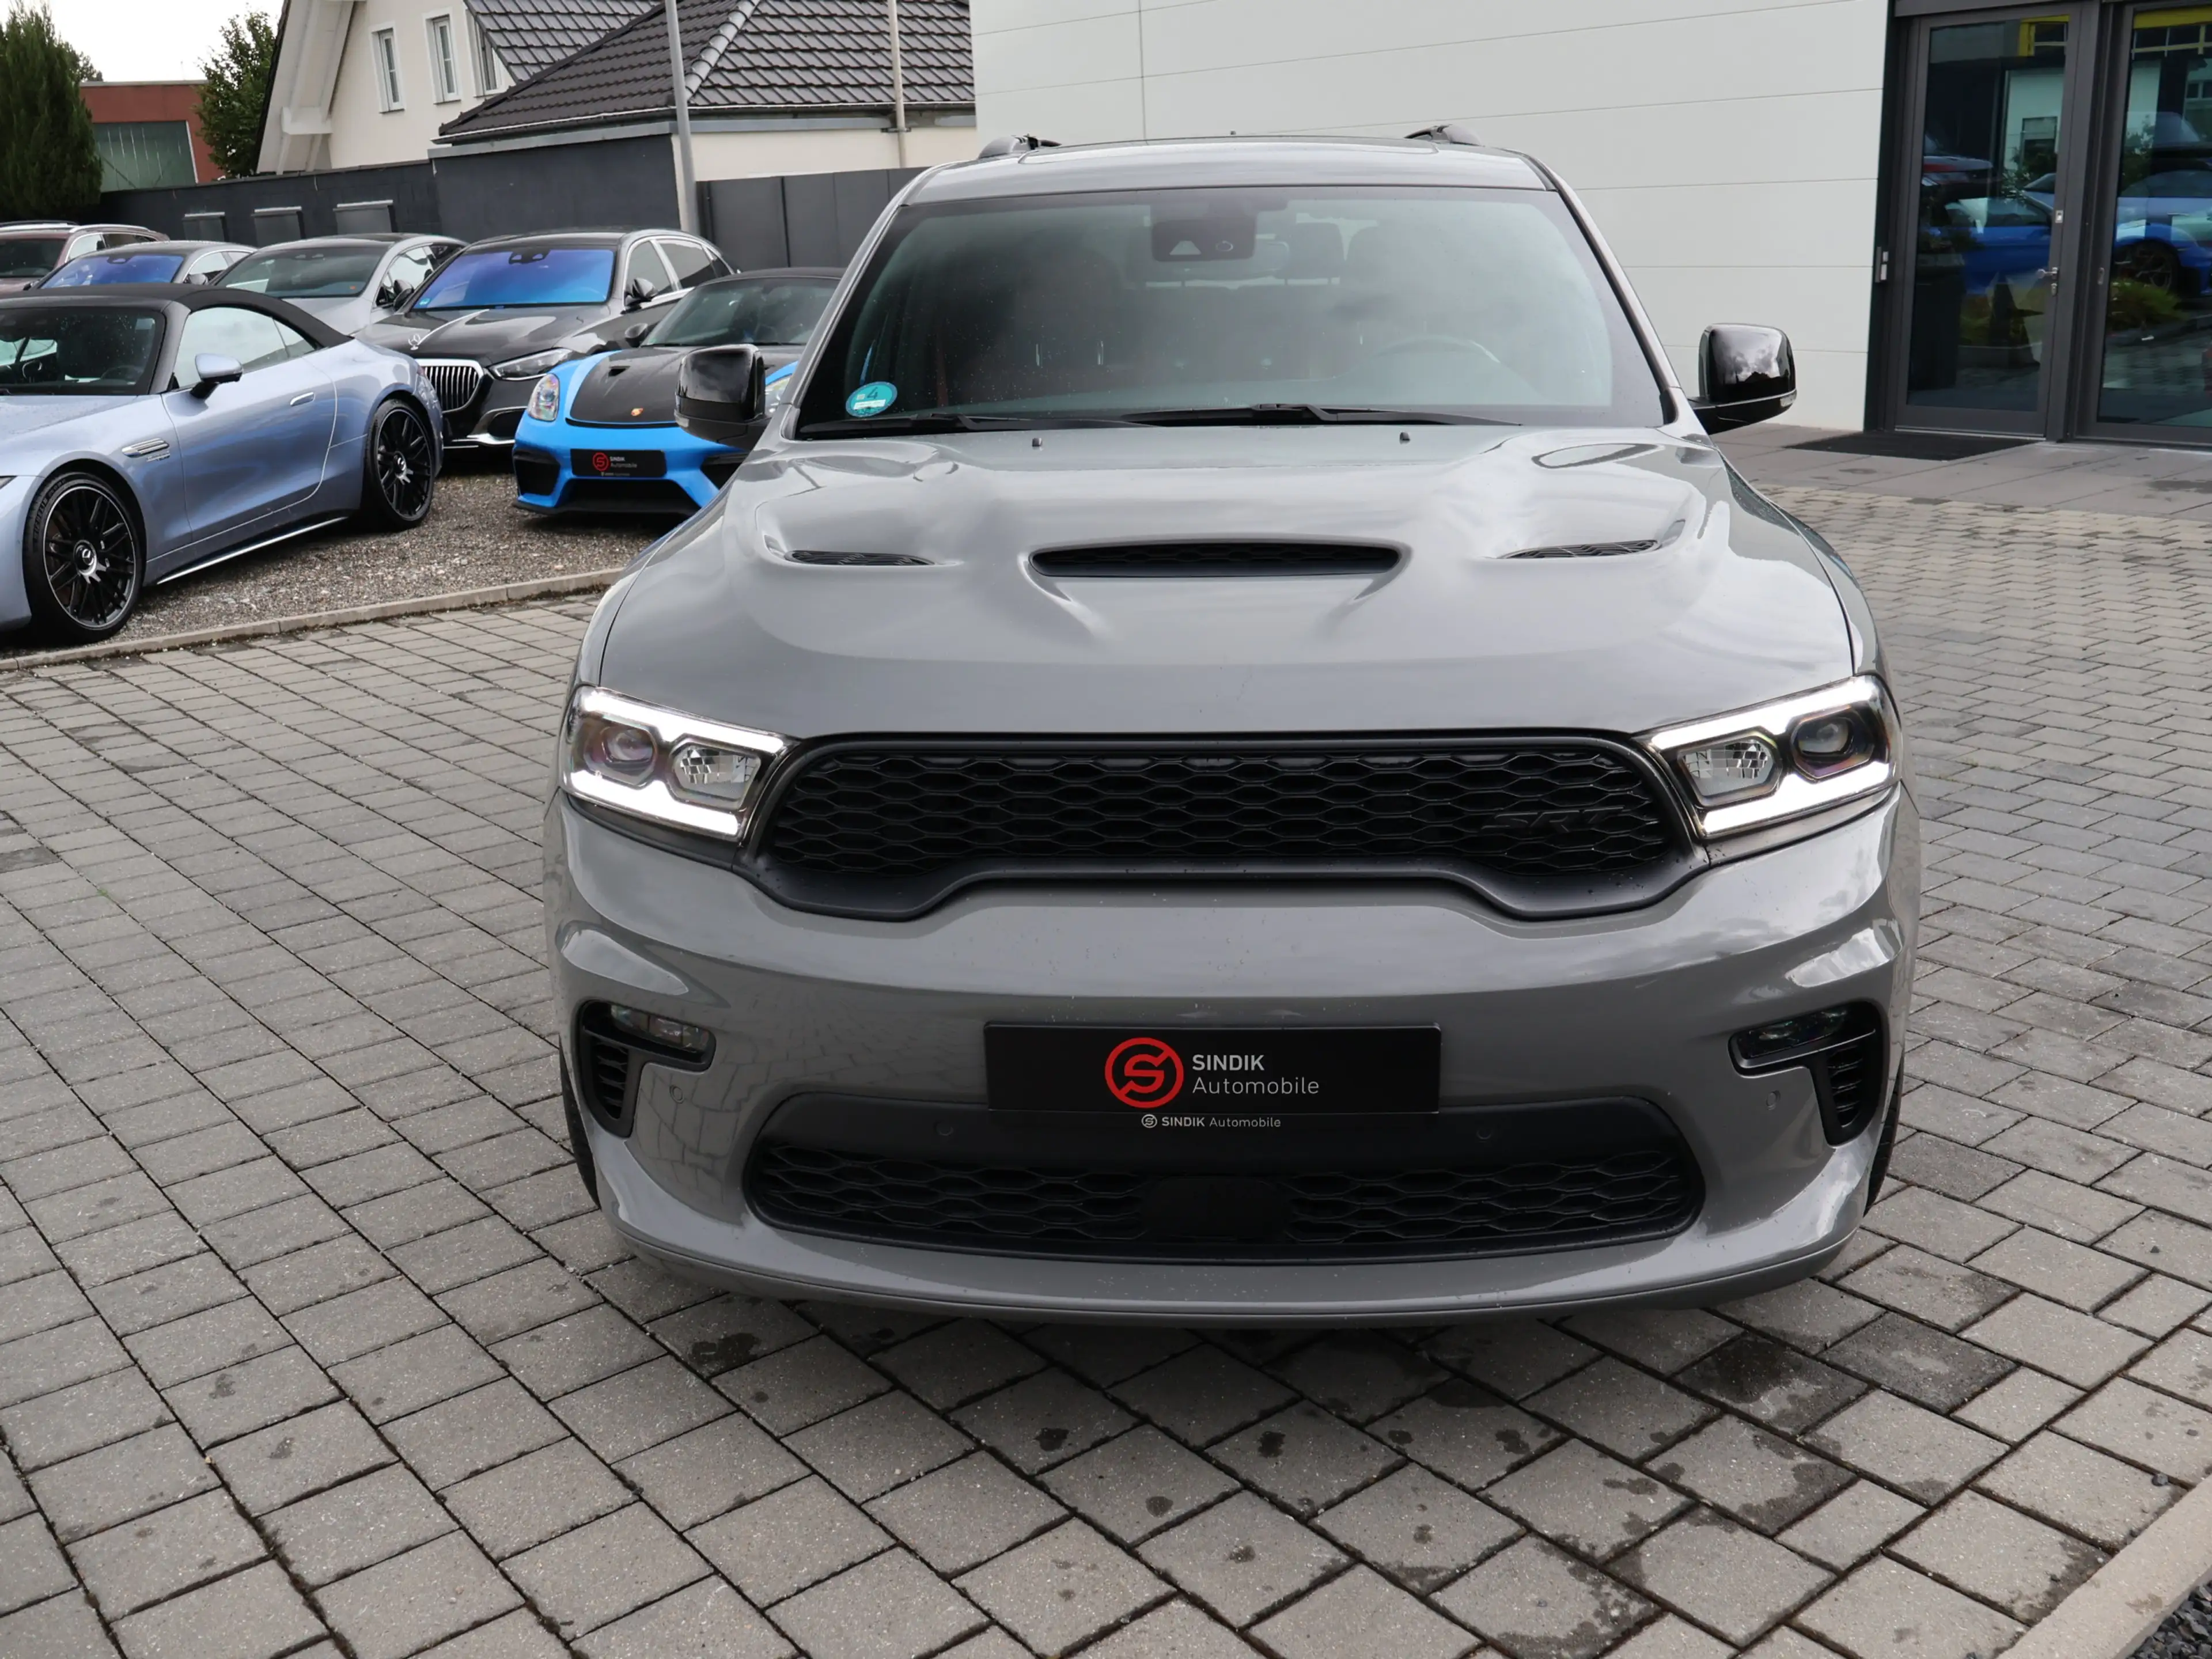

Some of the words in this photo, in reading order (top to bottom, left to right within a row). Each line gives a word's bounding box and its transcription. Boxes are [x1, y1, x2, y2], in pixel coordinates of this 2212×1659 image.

[867, 387, 878, 399] 4
[1192, 1055, 1264, 1070] SINDIK
[1193, 1077, 1319, 1094] Automobile
[1162, 1117, 1205, 1126] SINDIK
[1210, 1118, 1281, 1127] Automobile
